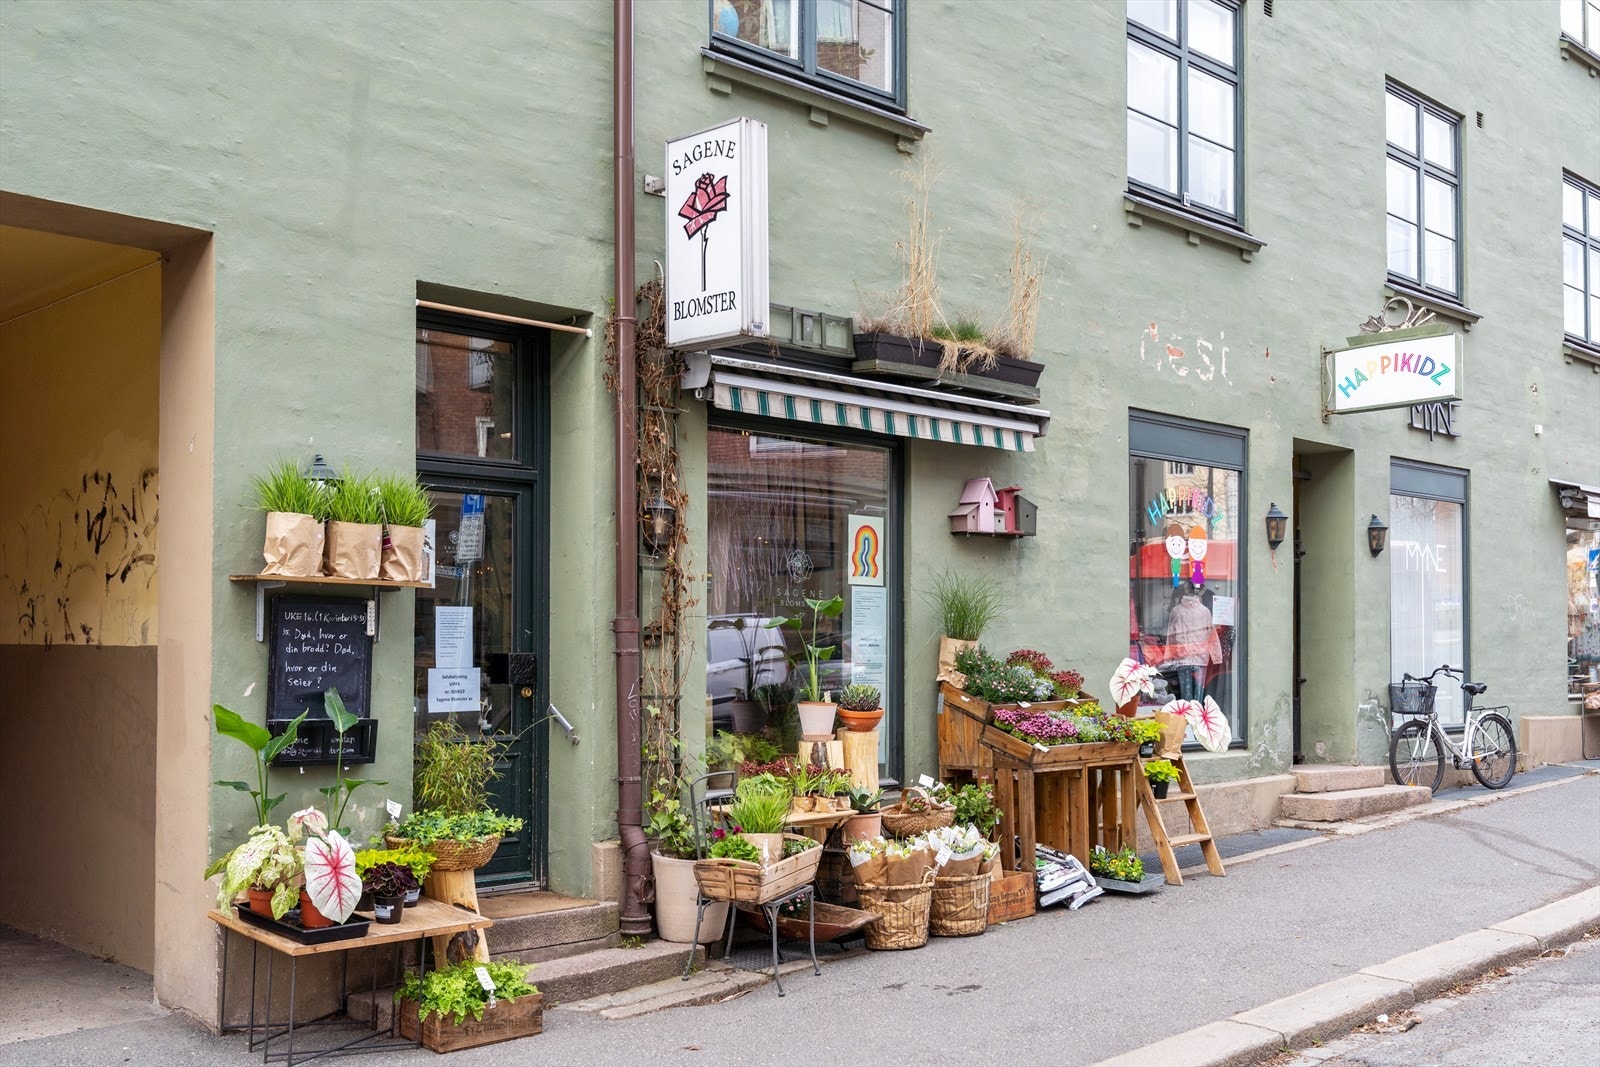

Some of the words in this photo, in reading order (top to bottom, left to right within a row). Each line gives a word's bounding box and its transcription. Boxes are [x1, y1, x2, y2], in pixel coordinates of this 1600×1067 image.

[672, 140, 737, 176] SAGENE
[673, 290, 737, 321] BLOMSTER
[1337, 352, 1451, 399] HAPPIKIDZ
[1147, 485, 1225, 531] HAPPIKIDZ
[1405, 543, 1448, 573] MYNE
[776, 587, 824, 598] SAGENE
[780, 600, 806, 608] BLOMS
[284, 611, 302, 621] UKE
[294, 628, 316, 640] Død,
[319, 628, 336, 640] hvor
[285, 642, 299, 653] din
[302, 642, 330, 653] brodd?
[334, 642, 355, 655] Død,
[285, 661, 303, 673] hvor
[320, 661, 337, 673] din
[287, 677, 313, 688] seier
